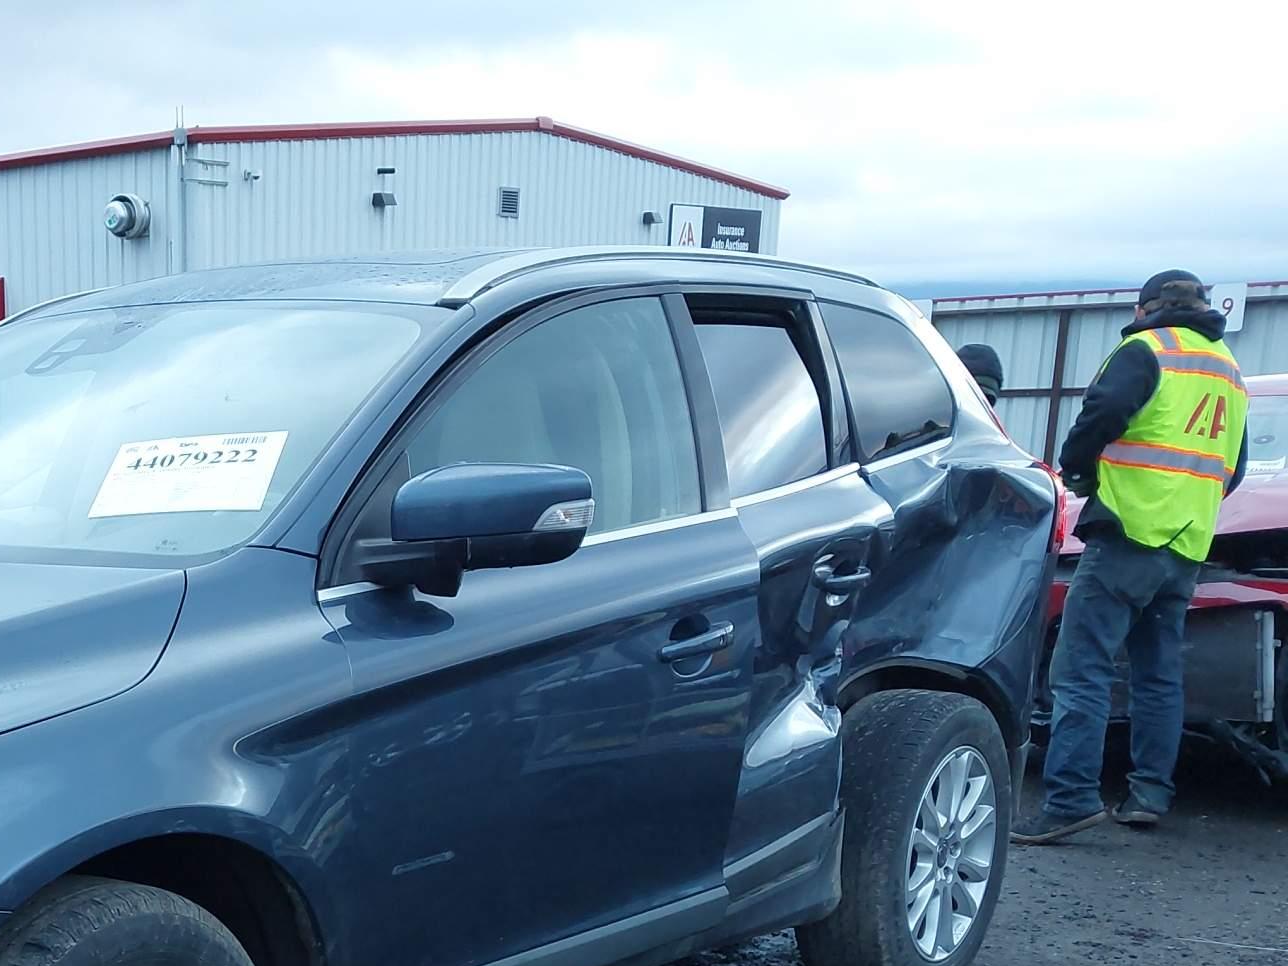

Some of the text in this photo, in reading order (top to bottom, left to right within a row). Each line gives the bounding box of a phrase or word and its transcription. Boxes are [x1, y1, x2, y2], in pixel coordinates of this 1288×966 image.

[717, 222, 745, 237] Insurance
[711, 237, 750, 251] Auto Auctions
[1222, 297, 1234, 317] 9
[126, 449, 258, 471] 44079222
